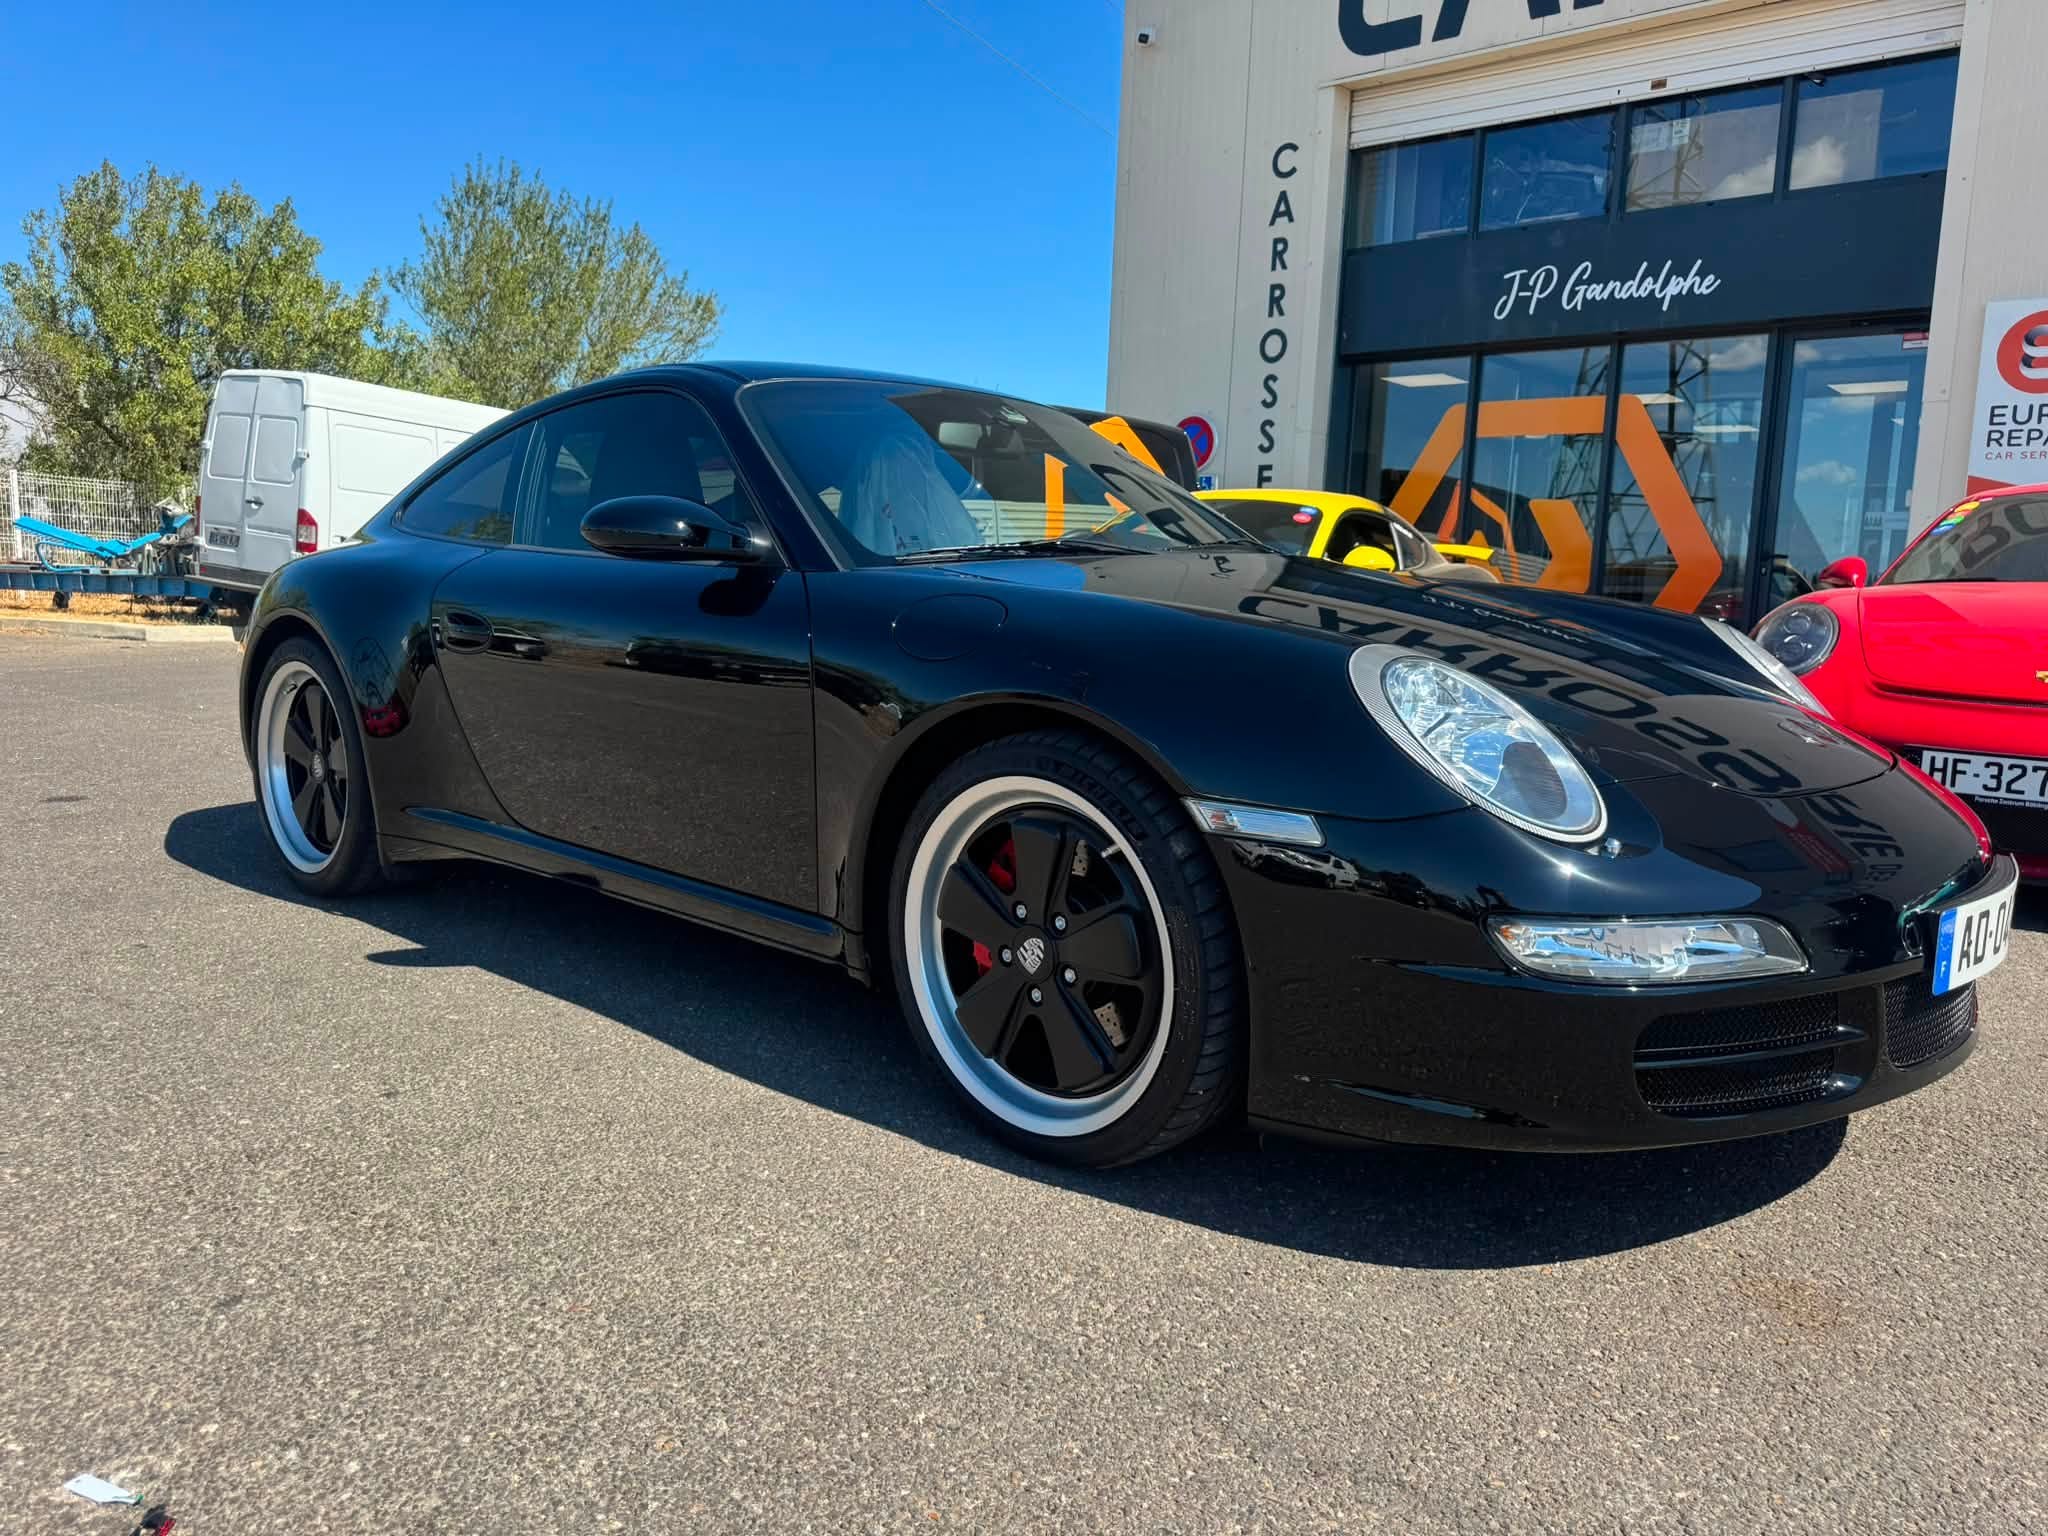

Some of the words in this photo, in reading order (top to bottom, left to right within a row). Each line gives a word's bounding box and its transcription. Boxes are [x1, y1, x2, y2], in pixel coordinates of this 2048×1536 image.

[1493, 264, 1559, 321] J-P
[1561, 258, 1722, 312] Gandolphe
[1986, 428, 2048, 448] REP
[1985, 451, 2014, 461] CAR
[1927, 755, 2048, 797] HF-327
